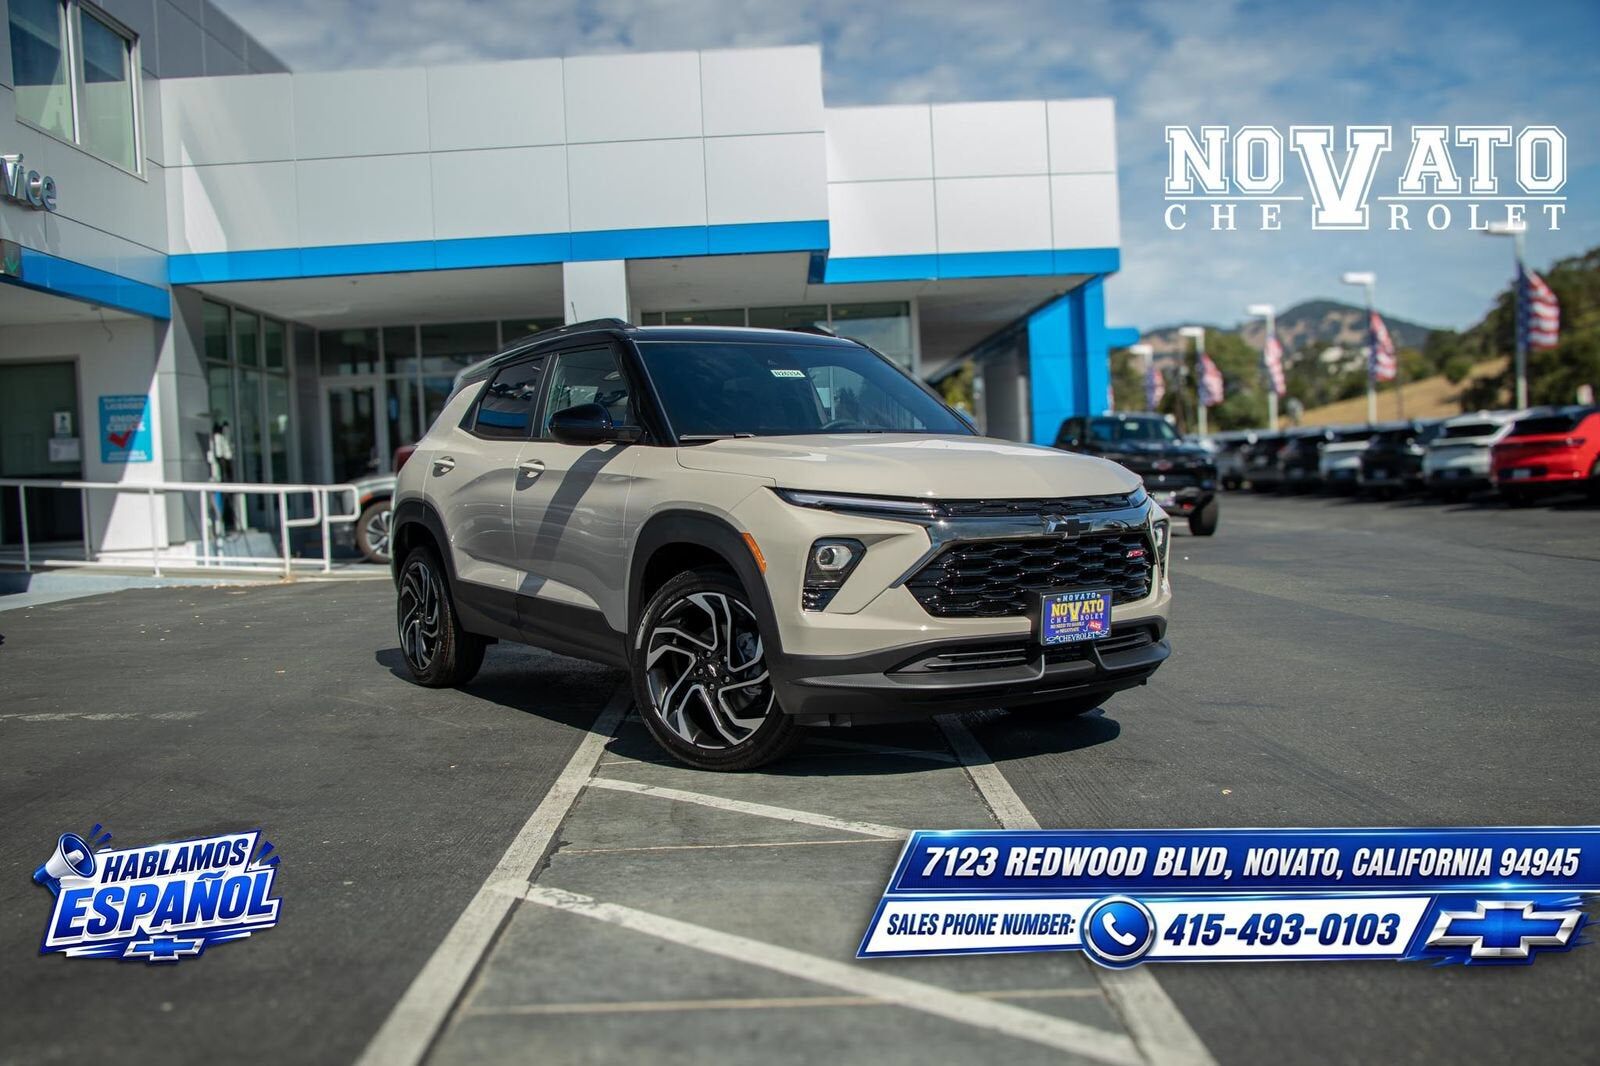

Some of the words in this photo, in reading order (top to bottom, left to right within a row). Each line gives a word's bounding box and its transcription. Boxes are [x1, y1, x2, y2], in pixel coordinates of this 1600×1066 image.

[1062, 592, 1096, 602] NOVATO
[1051, 599, 1104, 622] NOVATO
[1058, 631, 1096, 643] CHEVROLET
